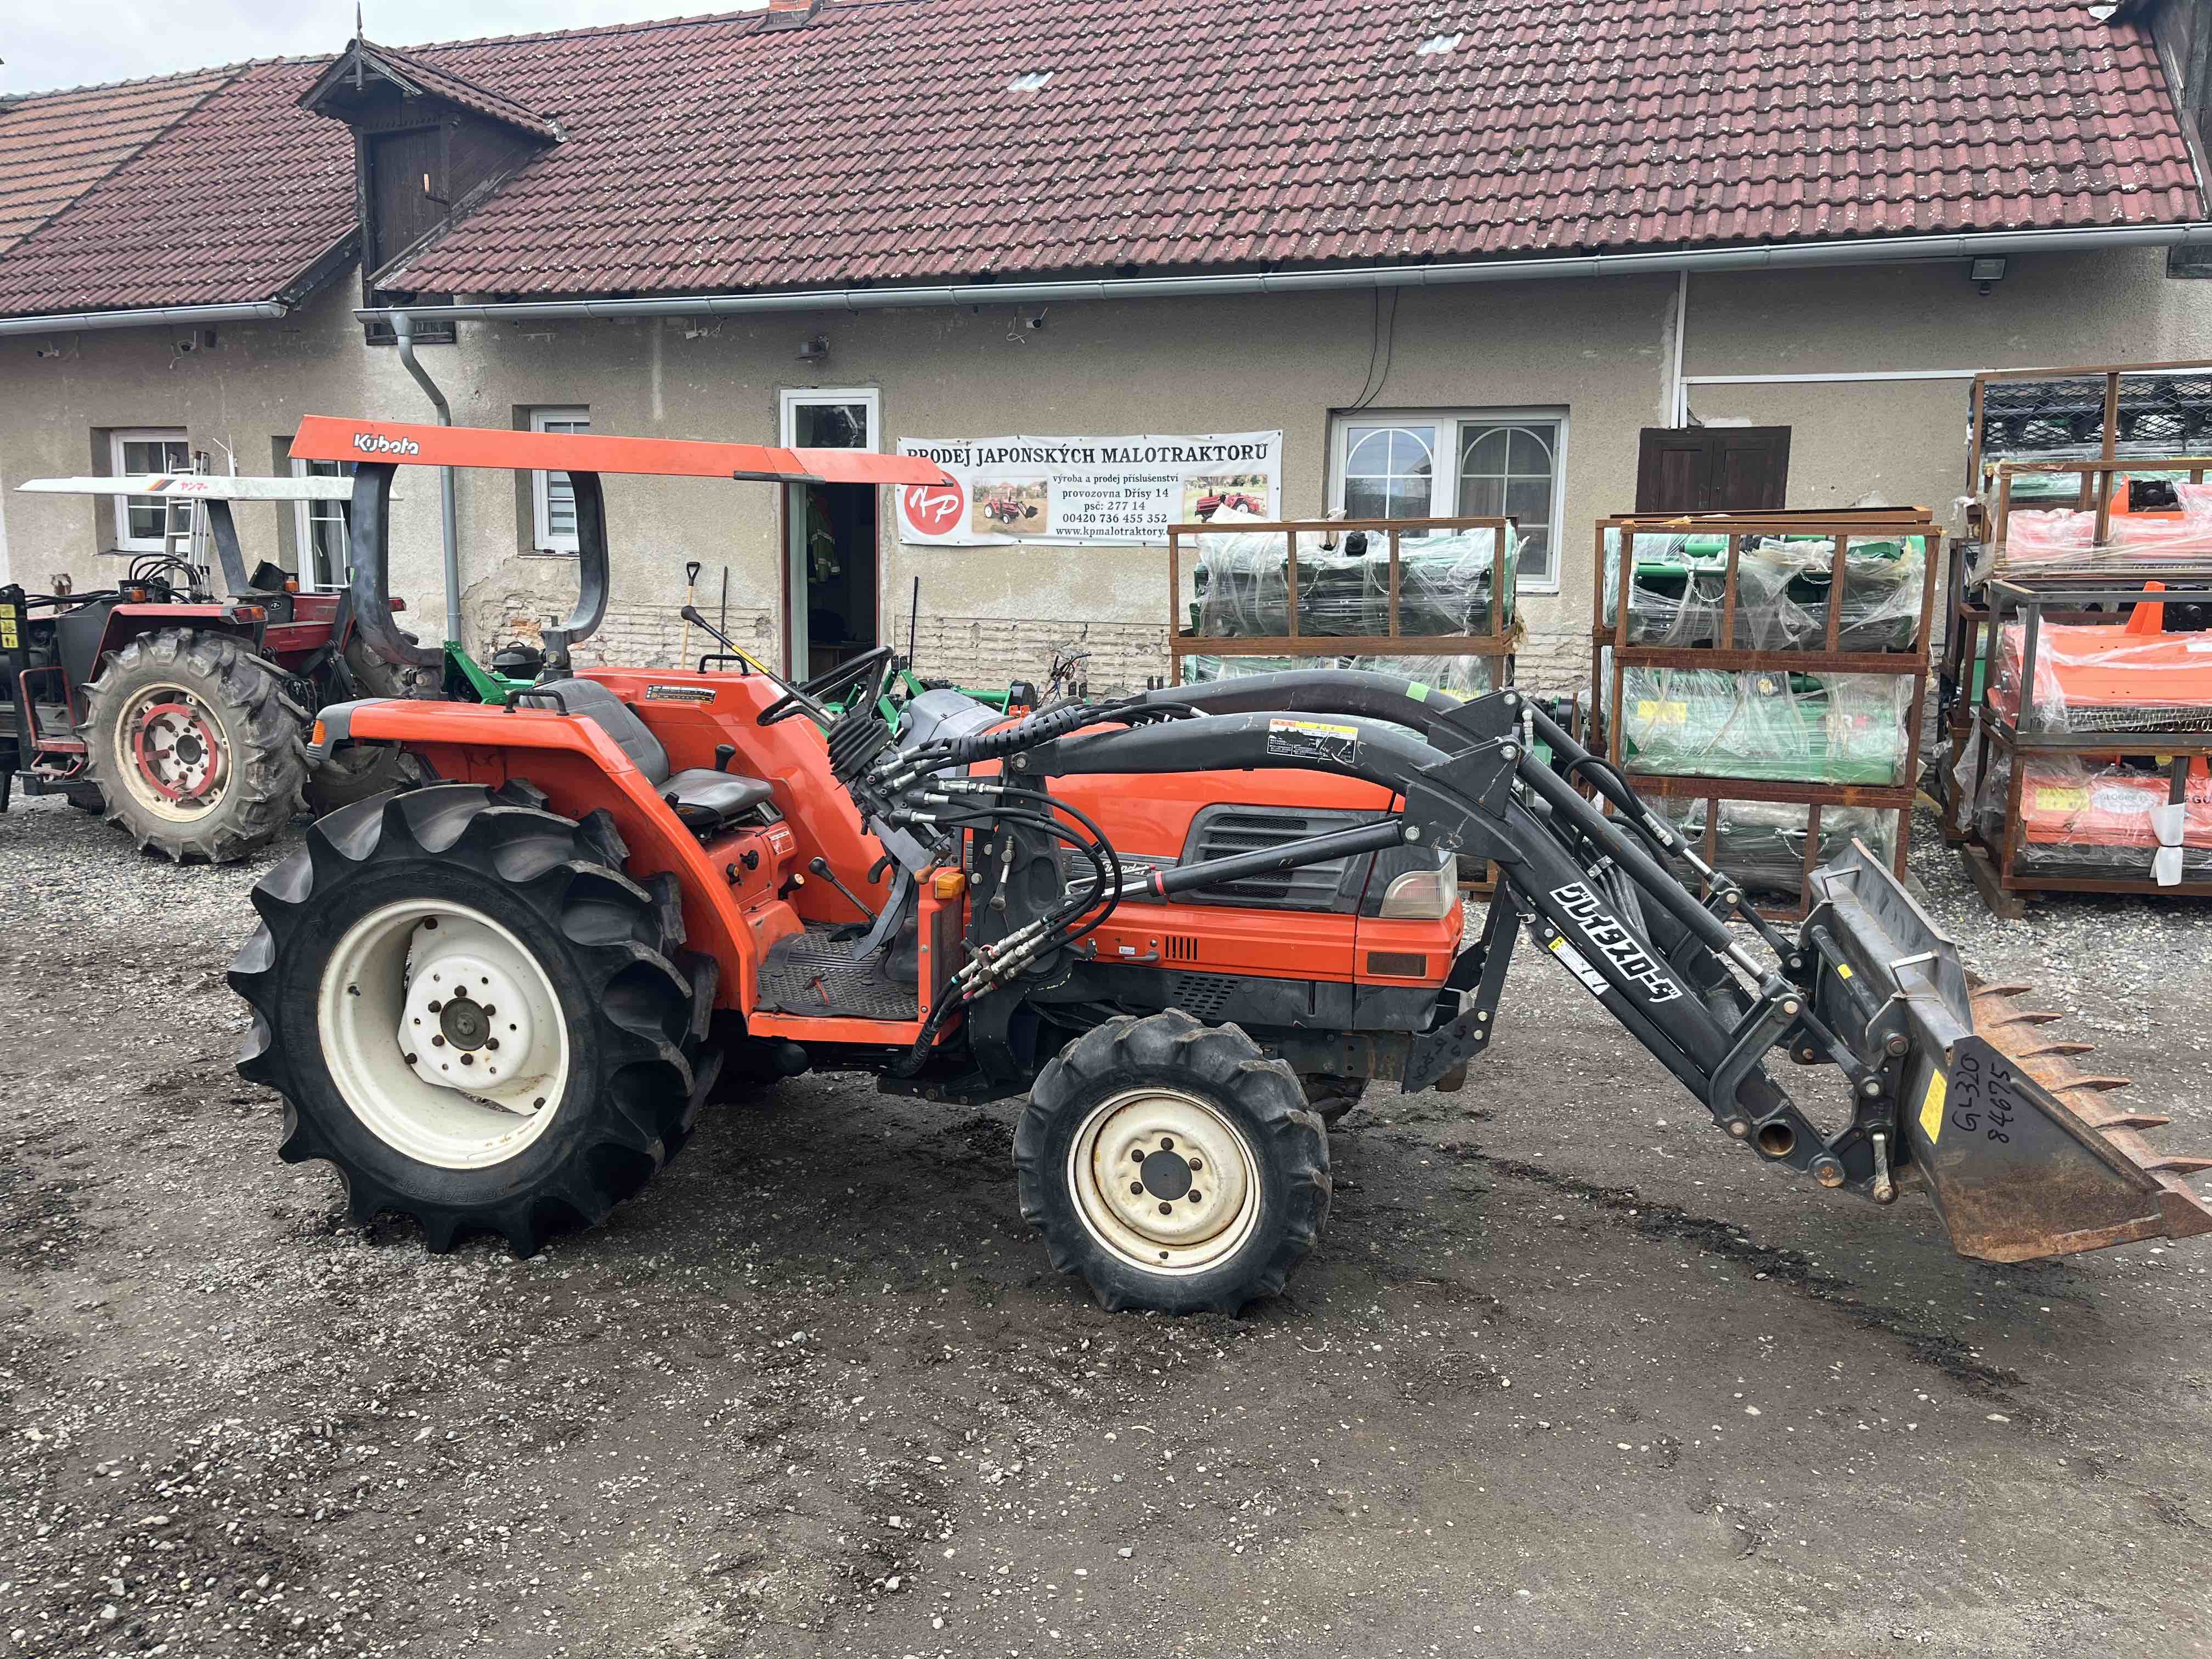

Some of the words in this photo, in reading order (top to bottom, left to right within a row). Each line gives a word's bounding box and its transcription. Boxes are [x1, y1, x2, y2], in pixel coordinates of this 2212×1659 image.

[353, 432, 420, 456] Kubota
[977, 443, 1096, 467] JAPONSKÝCH
[1053, 474, 1082, 483] výroba
[1093, 475, 1120, 484] prodej
[1123, 473, 1179, 484] příslušenství
[1062, 490, 1120, 499] provozovna
[1125, 488, 1152, 499] Dřísy
[1155, 488, 1169, 498] 14
[1084, 501, 1104, 512] psč:
[1107, 501, 1128, 510] 277
[1132, 501, 1146, 510] 14
[1062, 514, 1096, 523] 00420
[1099, 514, 1119, 523] 736
[1122, 514, 1143, 523] 455
[1147, 514, 1167, 523] 352
[1056, 527, 1168, 538] www.kpmalotraktory.
[1987, 1063, 2014, 1144] 84675
